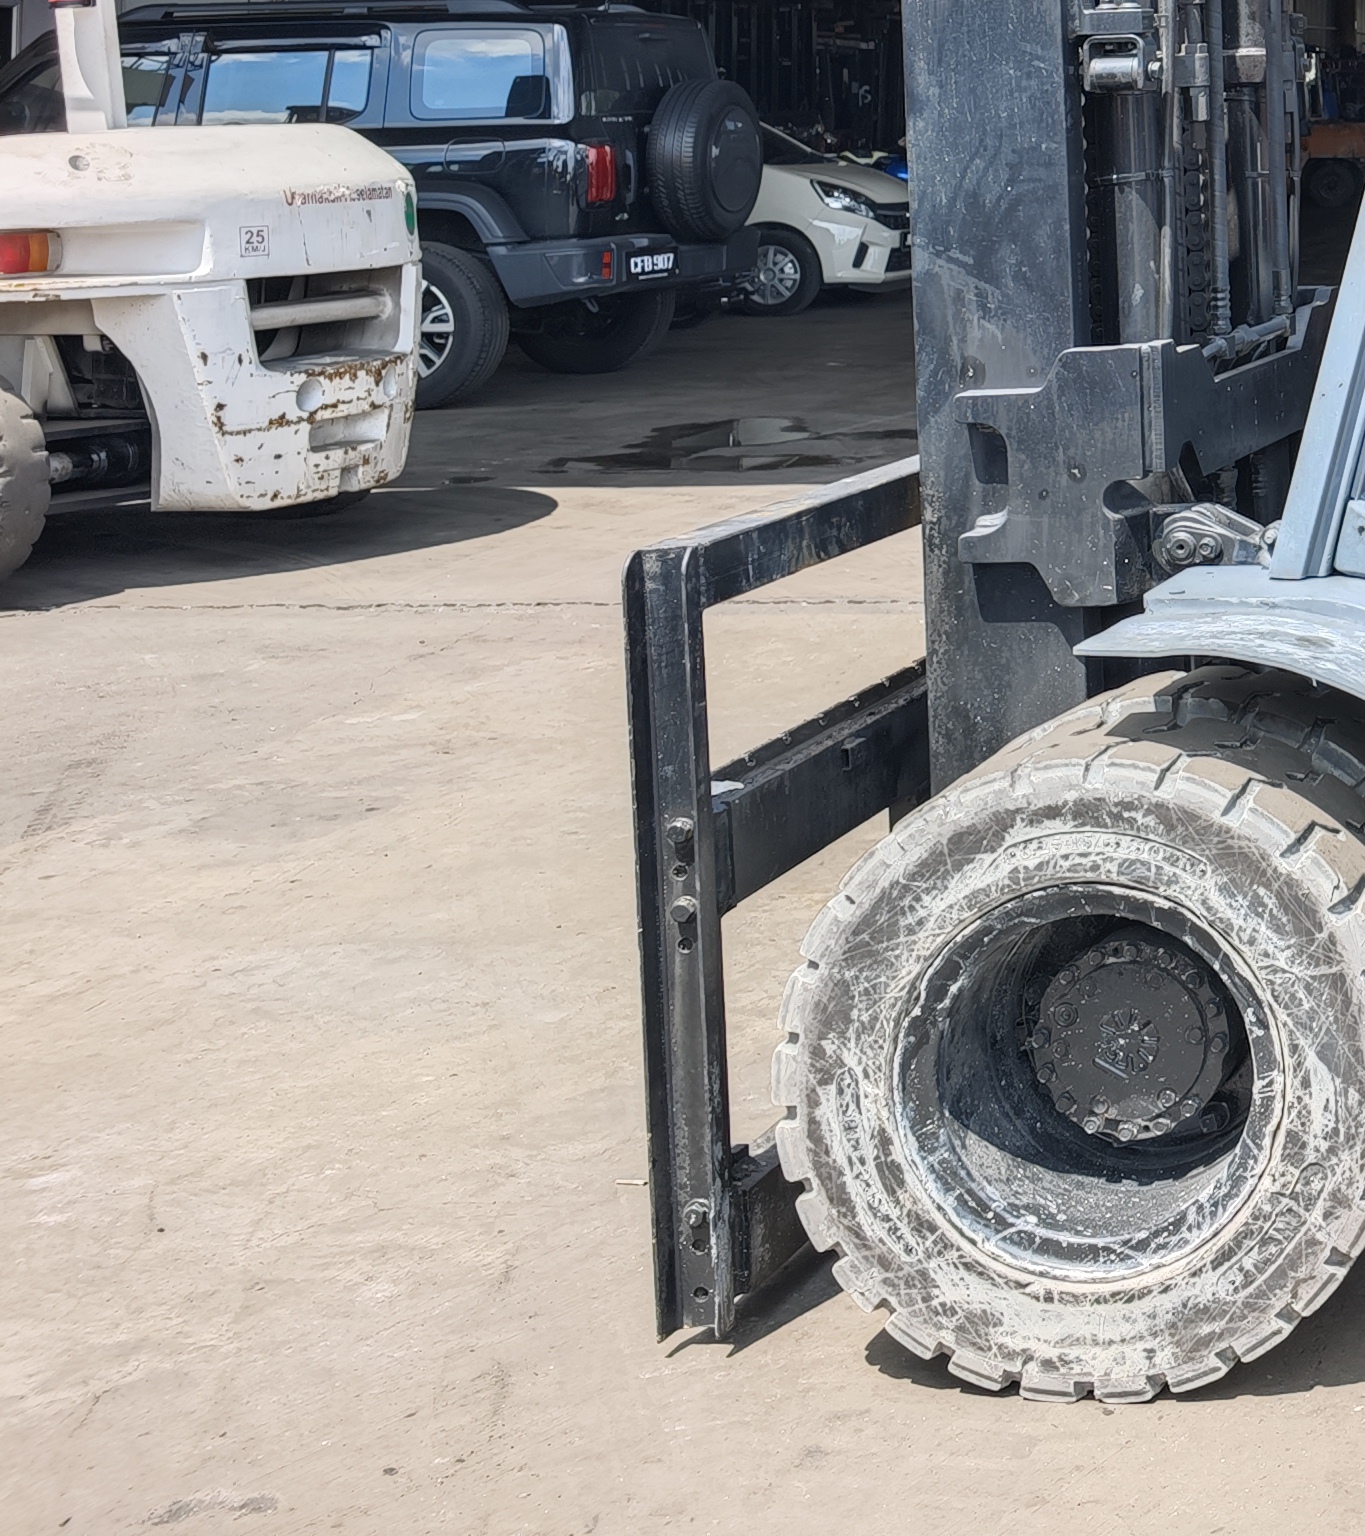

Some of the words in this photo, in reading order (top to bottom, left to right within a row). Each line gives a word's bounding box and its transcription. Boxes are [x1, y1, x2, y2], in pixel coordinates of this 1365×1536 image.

[244, 229, 265, 245] 25
[630, 256, 652, 274] CFB
[653, 253, 675, 271] 907
